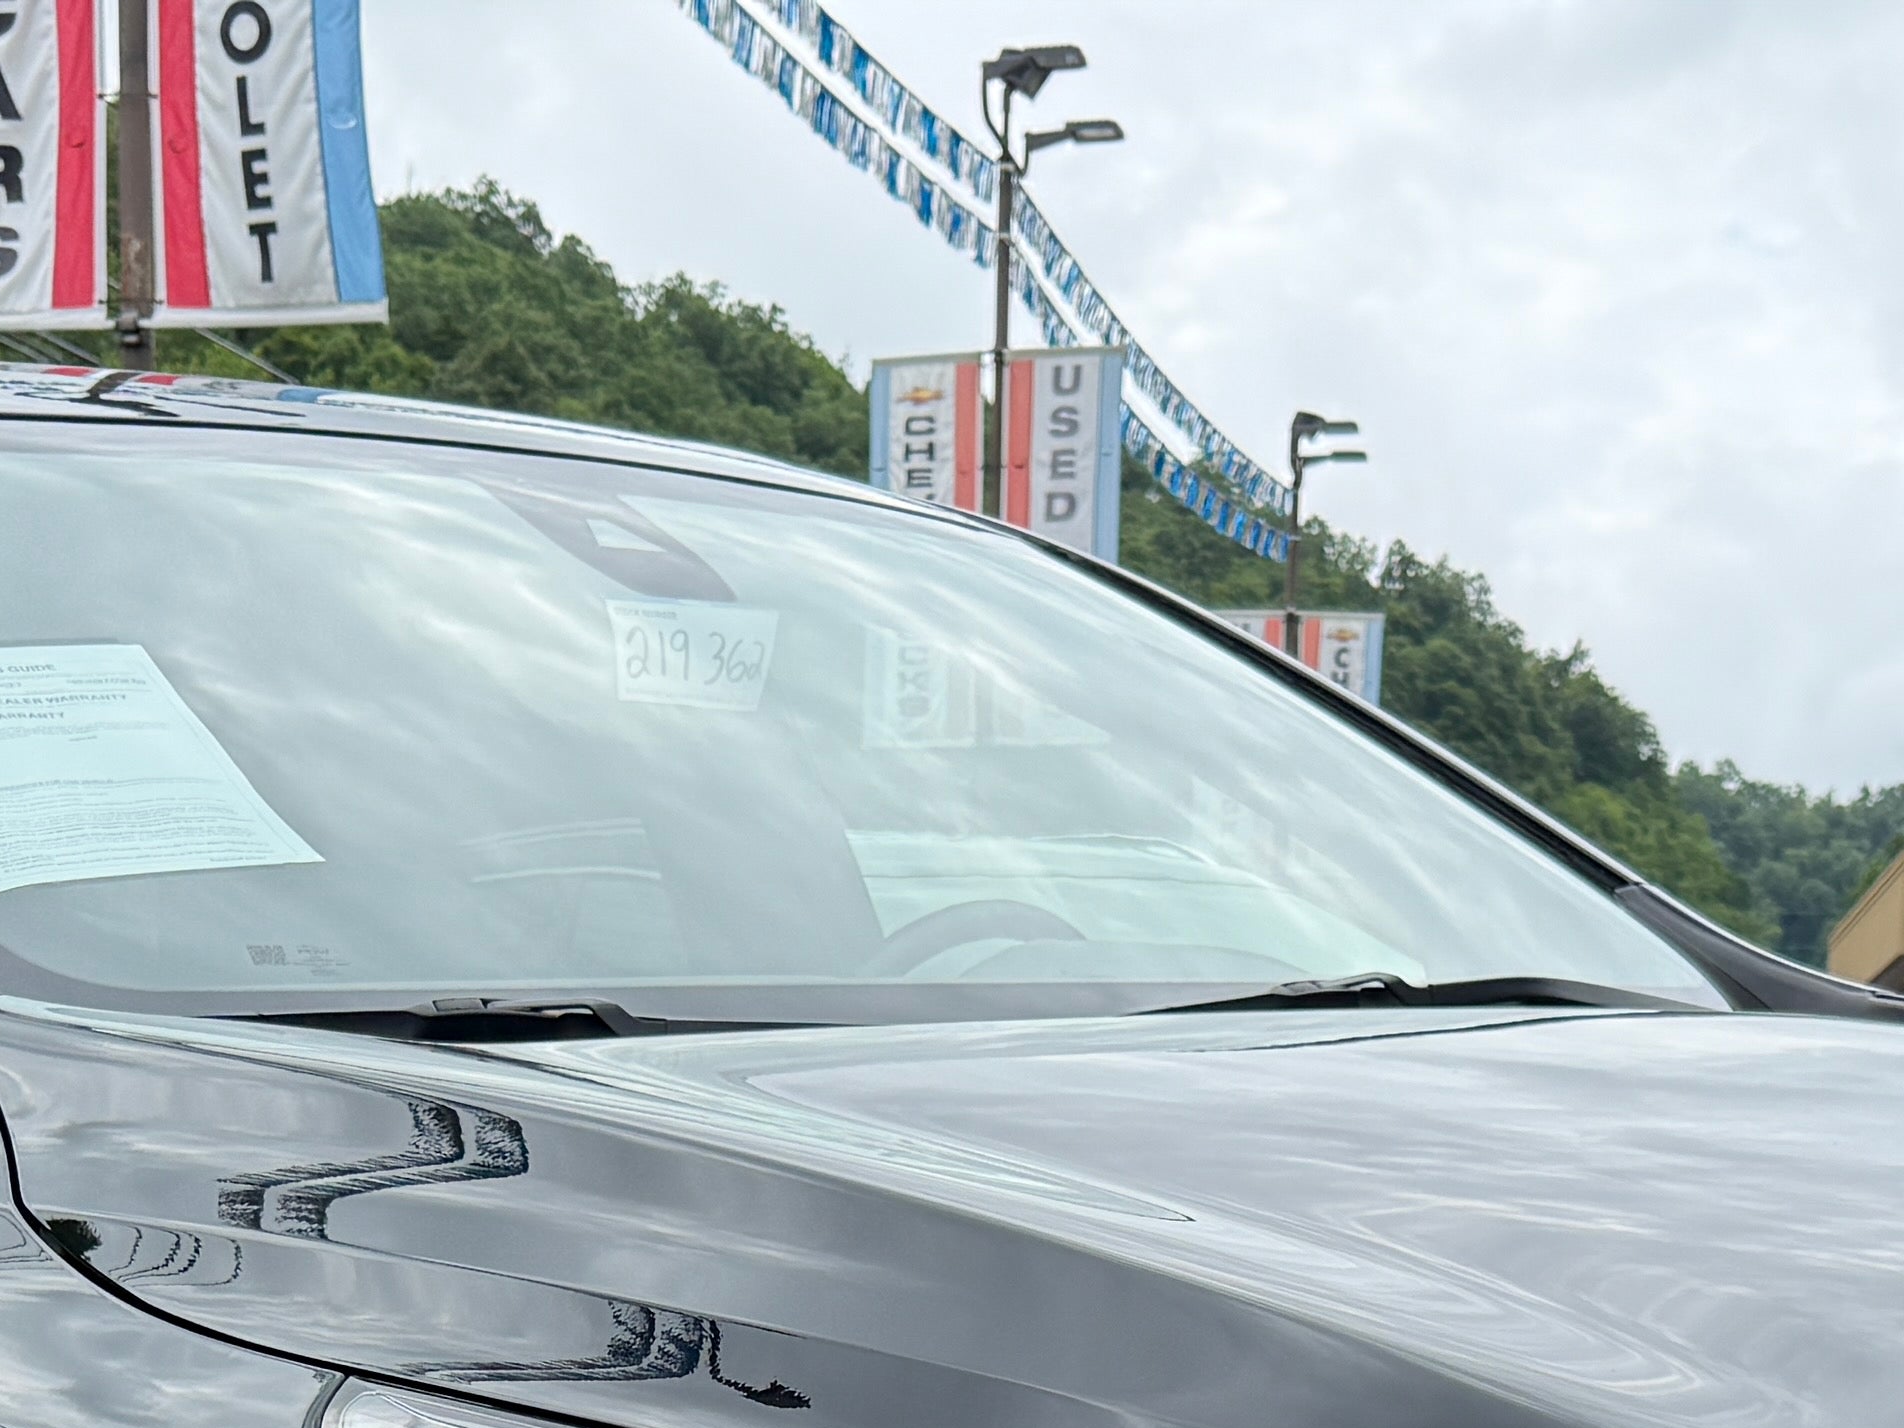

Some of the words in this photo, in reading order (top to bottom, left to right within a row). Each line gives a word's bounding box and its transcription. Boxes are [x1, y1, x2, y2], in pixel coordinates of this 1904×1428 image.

[220, 0, 278, 283] OLET
[904, 416, 936, 501] CHE
[1044, 364, 1082, 523] USED
[7, 663, 58, 674] GUIDE
